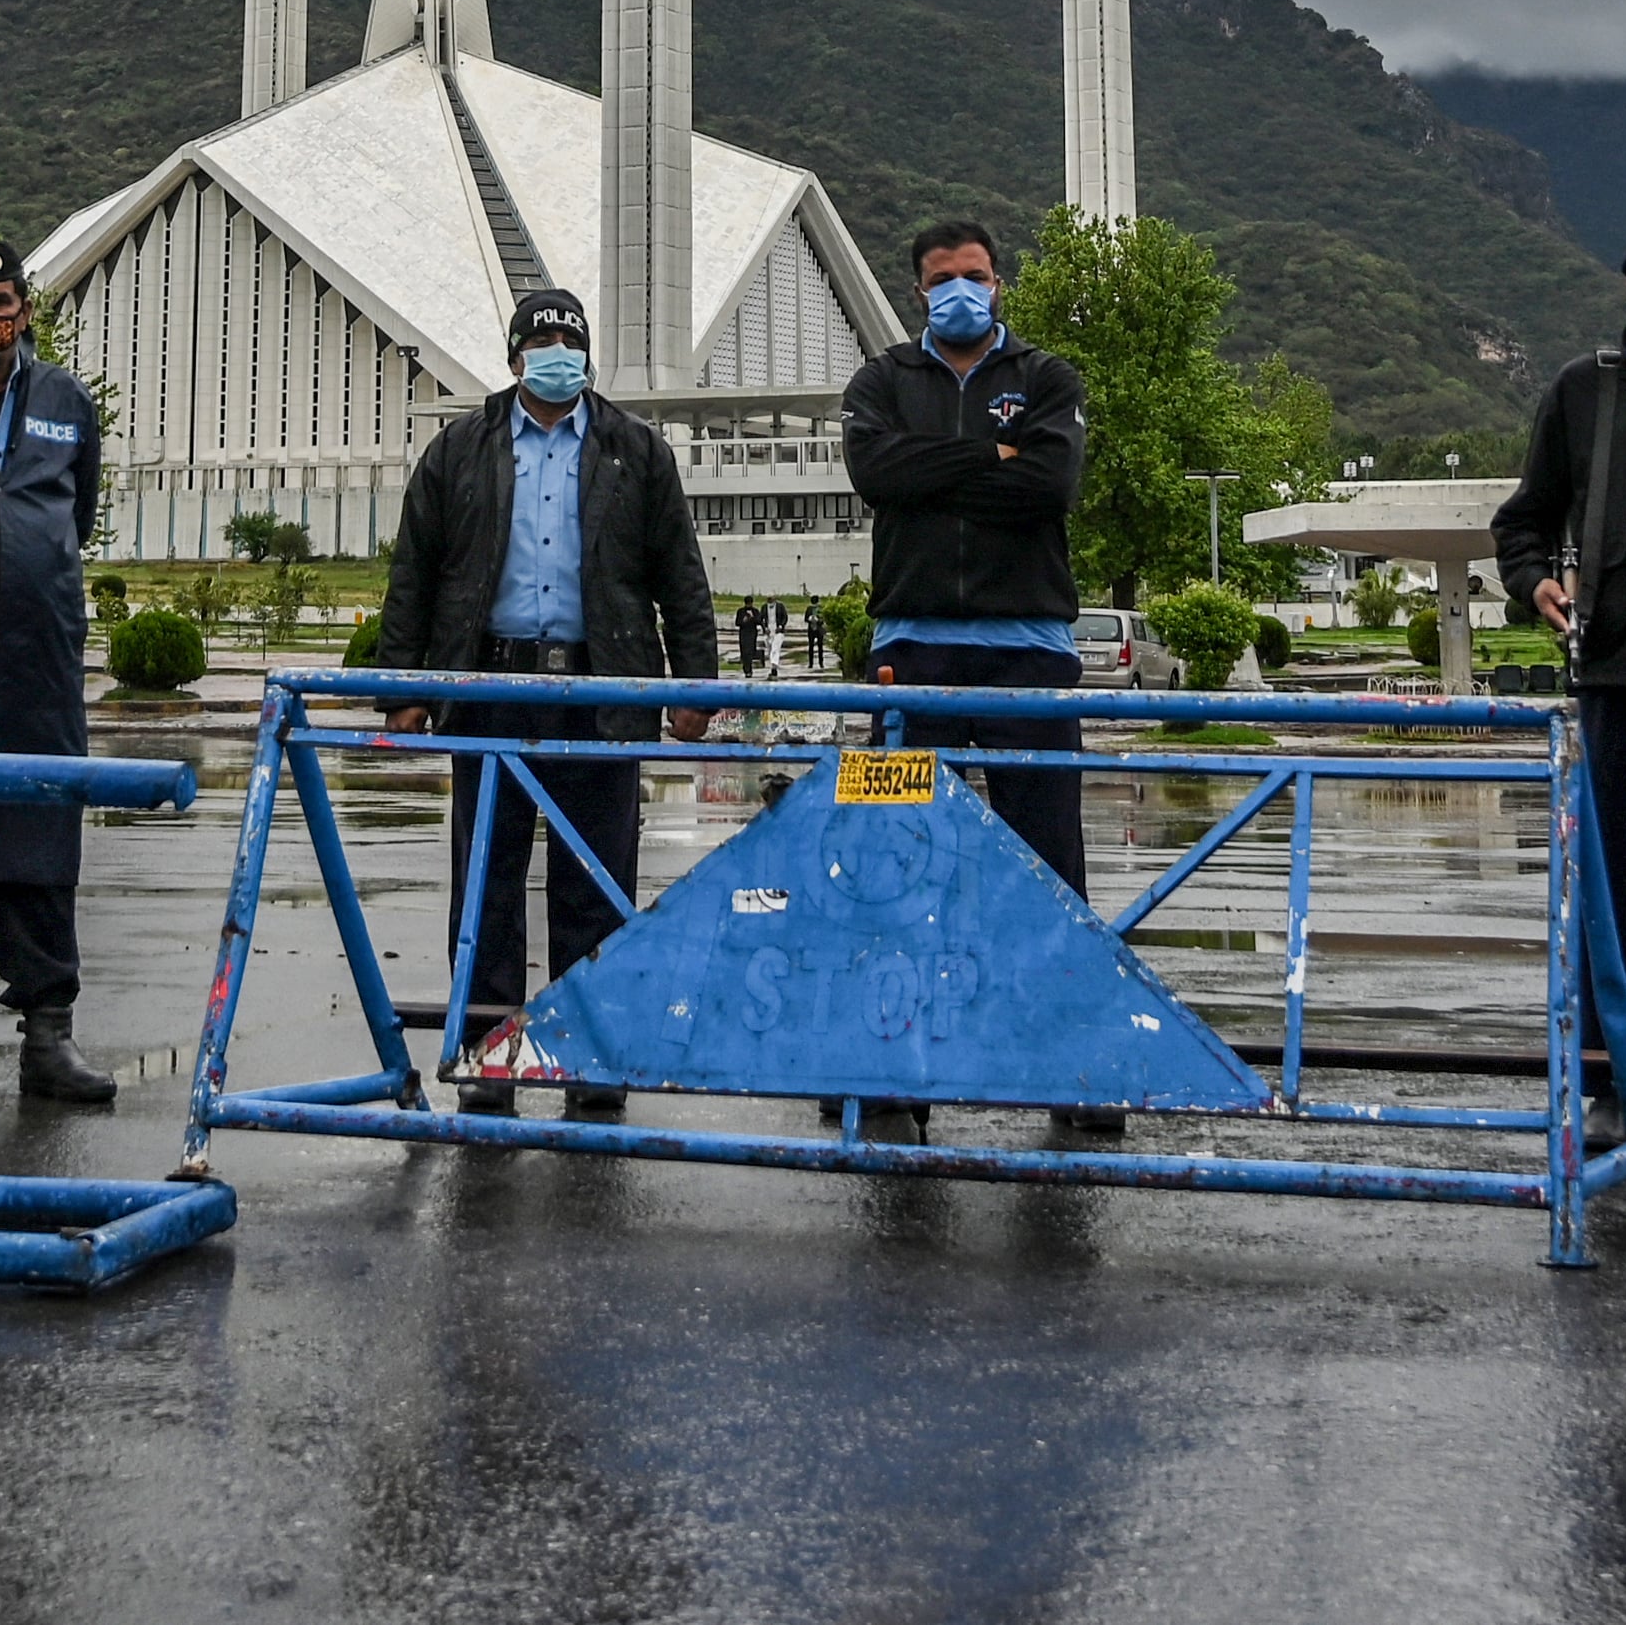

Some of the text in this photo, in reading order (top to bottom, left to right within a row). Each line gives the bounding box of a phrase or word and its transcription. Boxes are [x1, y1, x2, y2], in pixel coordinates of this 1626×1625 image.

[533, 308, 584, 334] POLICE
[25, 416, 75, 442] POLICE
[863, 763, 932, 795] 5552444
[741, 946, 979, 1040] STOP
